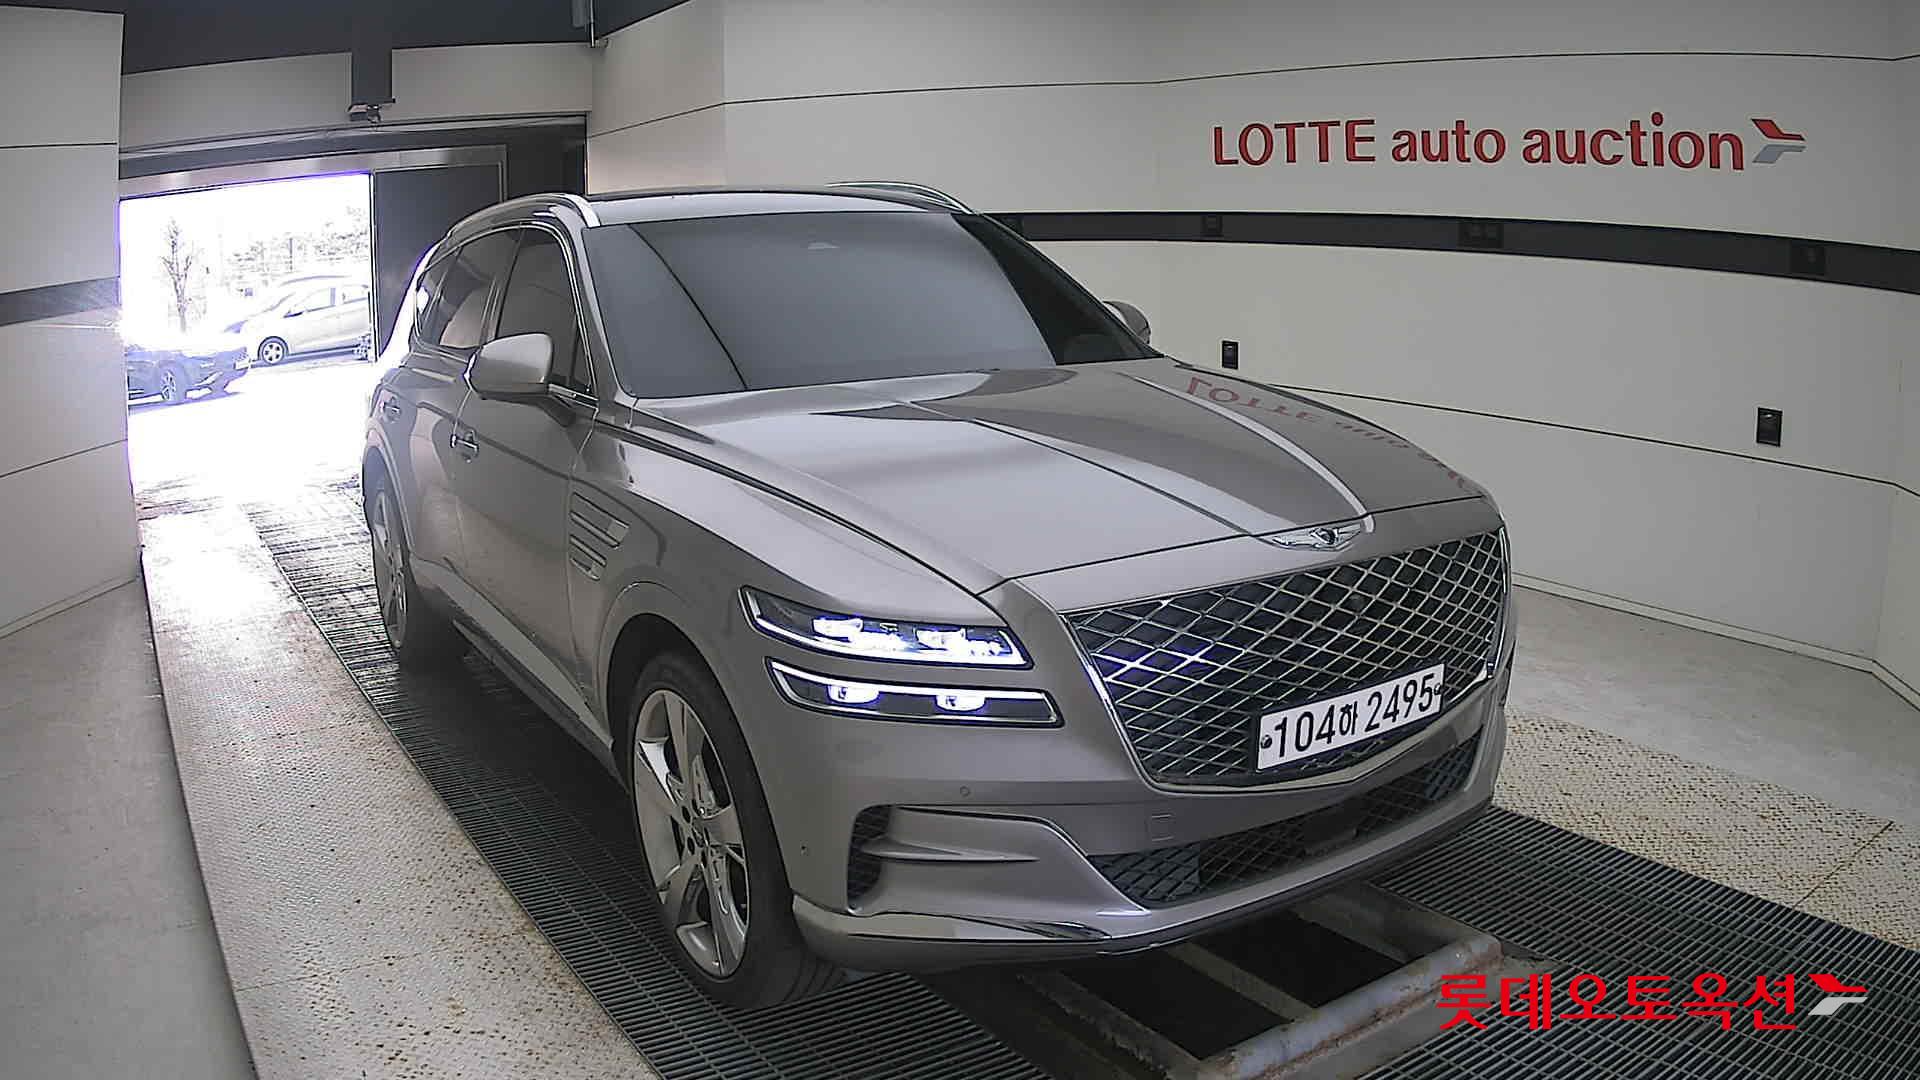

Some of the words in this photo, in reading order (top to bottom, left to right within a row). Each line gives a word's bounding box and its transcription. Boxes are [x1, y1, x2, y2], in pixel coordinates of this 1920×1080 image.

[1215, 120, 1375, 164] LOTTE
[1393, 122, 1507, 163] auto
[1522, 113, 1744, 169] auction
[1274, 701, 1358, 758] 104하
[1364, 672, 1435, 733] 2495
